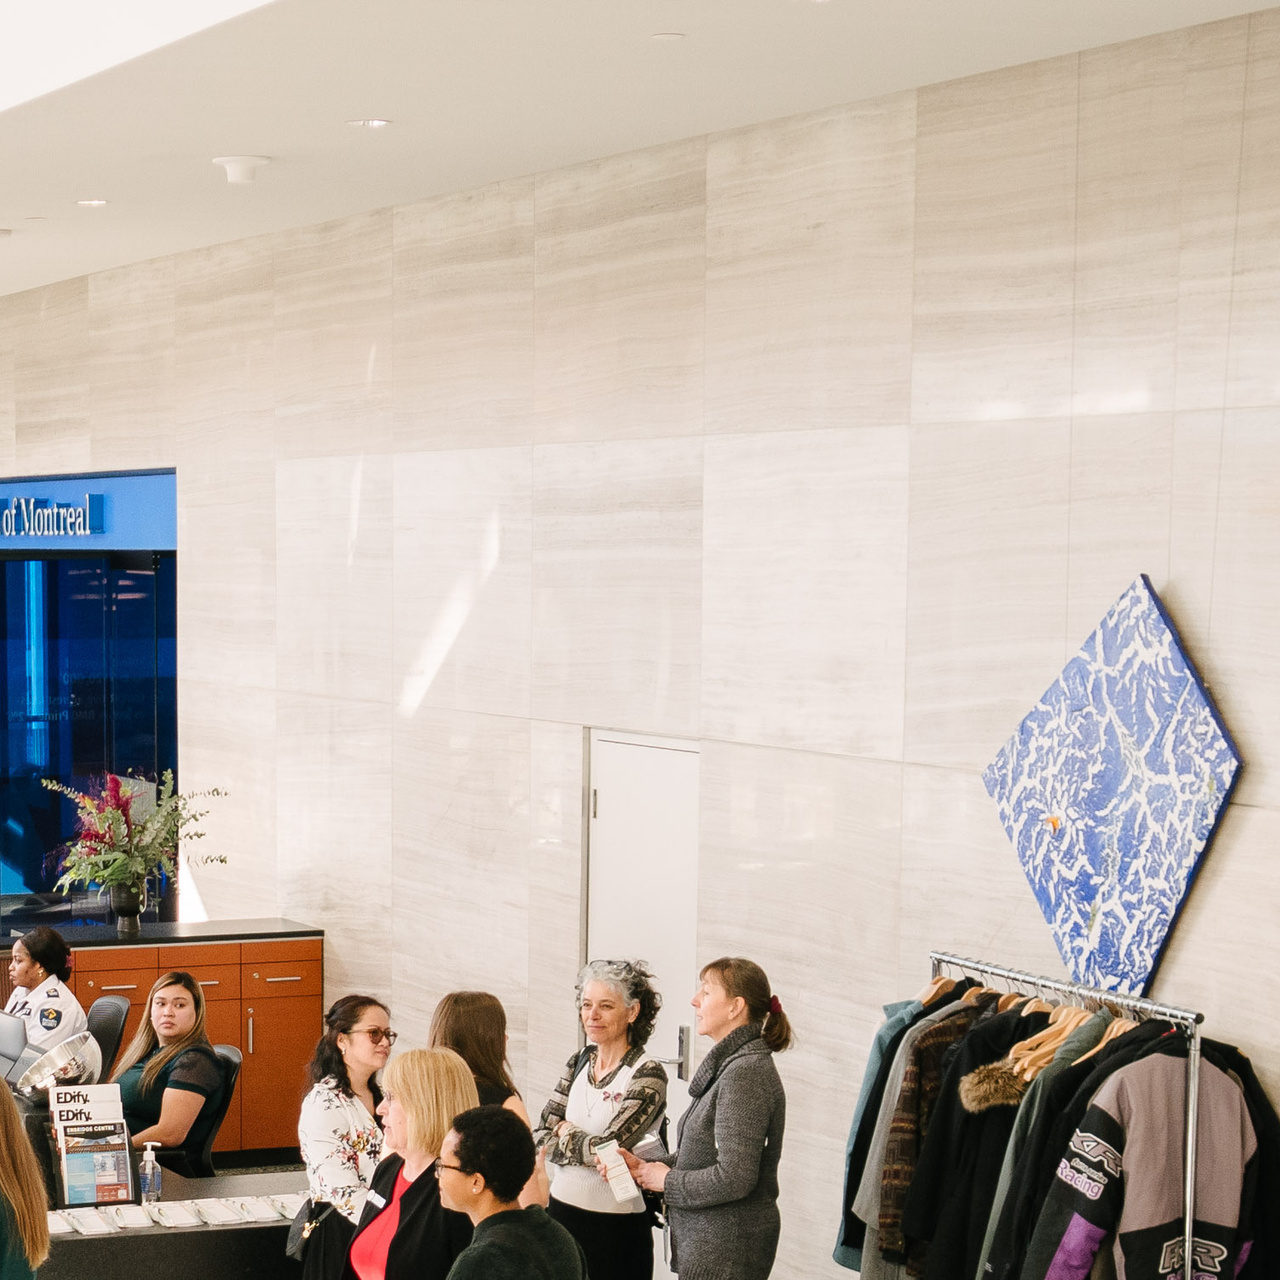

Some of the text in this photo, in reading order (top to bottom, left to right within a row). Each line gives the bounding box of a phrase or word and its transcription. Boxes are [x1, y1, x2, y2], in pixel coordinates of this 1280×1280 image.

[3, 497, 17, 537] of
[20, 493, 91, 537] Montreal
[56, 1091, 90, 1104] EDify.
[59, 1108, 93, 1122] EDify.
[1057, 1158, 1104, 1200] Racing
